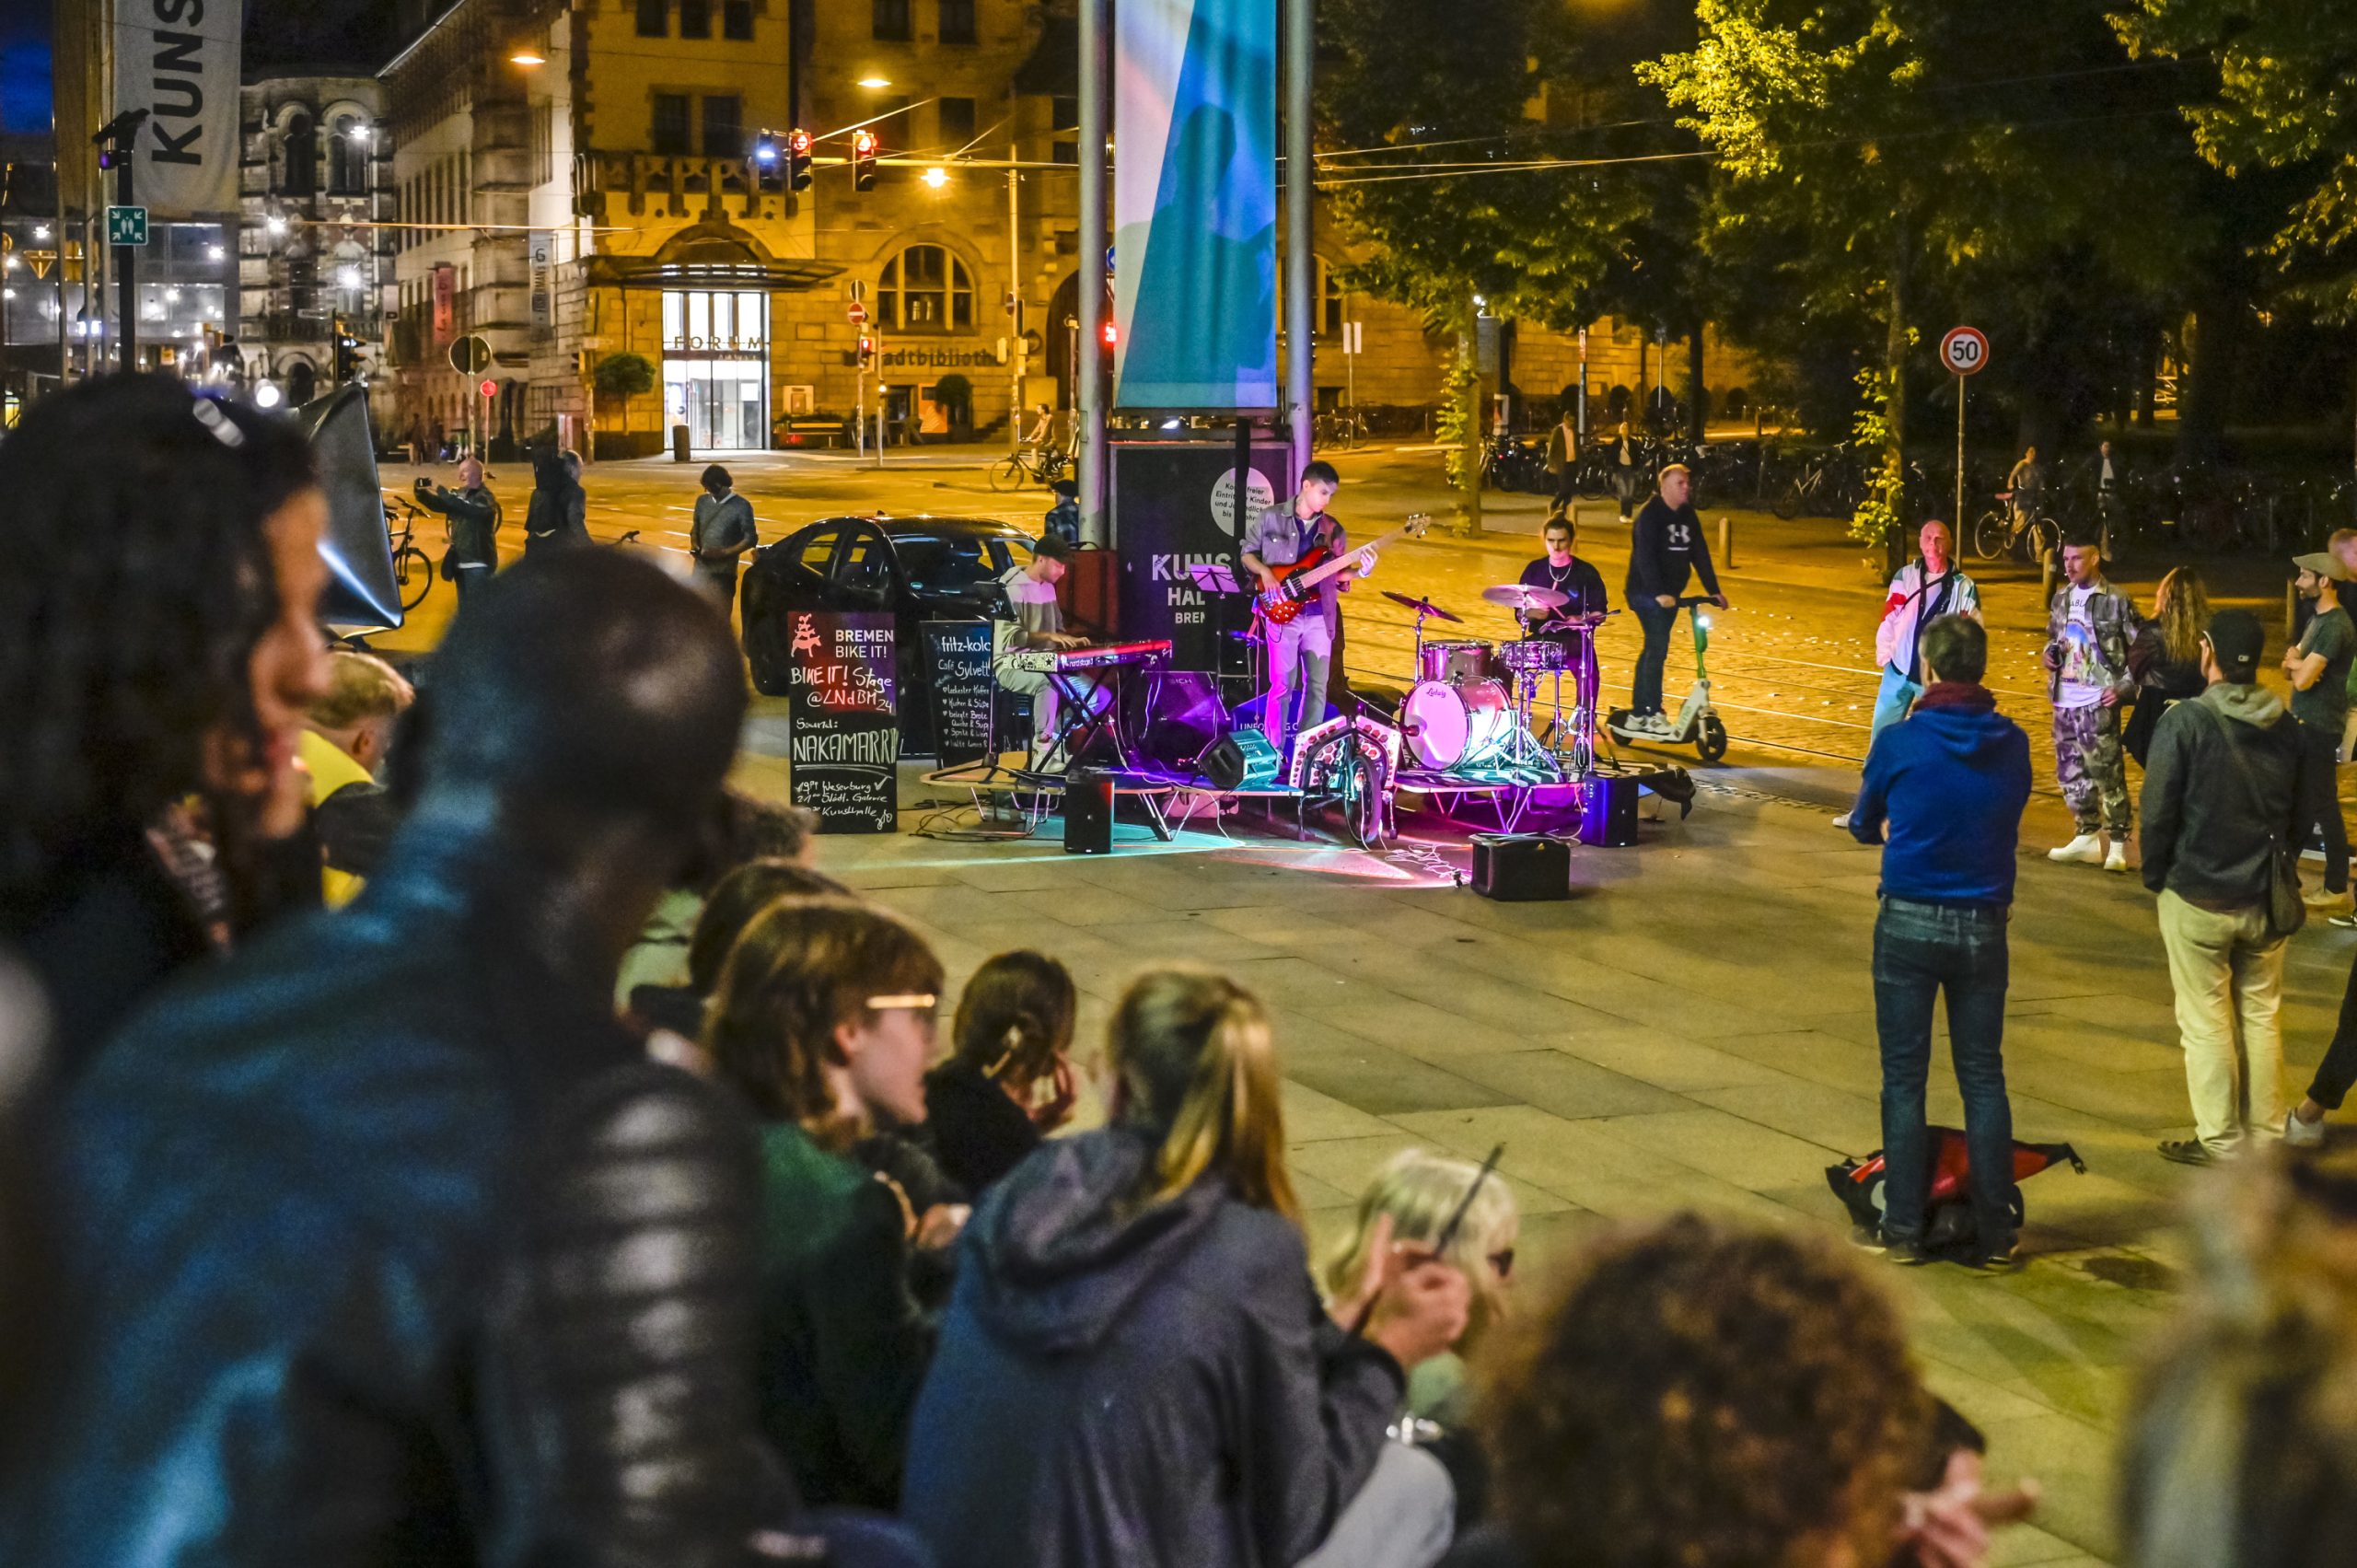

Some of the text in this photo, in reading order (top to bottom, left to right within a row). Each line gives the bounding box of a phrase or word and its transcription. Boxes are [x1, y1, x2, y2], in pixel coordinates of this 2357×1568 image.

[674, 336, 763, 350] FORUM
[1953, 341, 1979, 361] 50
[1249, 495, 1271, 505] Kinder
[1152, 553, 1232, 580] KUNS
[1167, 587, 1205, 606] HAL
[835, 630, 894, 642] BREMEN
[835, 645, 887, 658] BIKE IT!
[955, 659, 991, 680] Sylvett
[791, 665, 892, 693] BIKE IT! Stage
[822, 781, 871, 794] Weserburg
